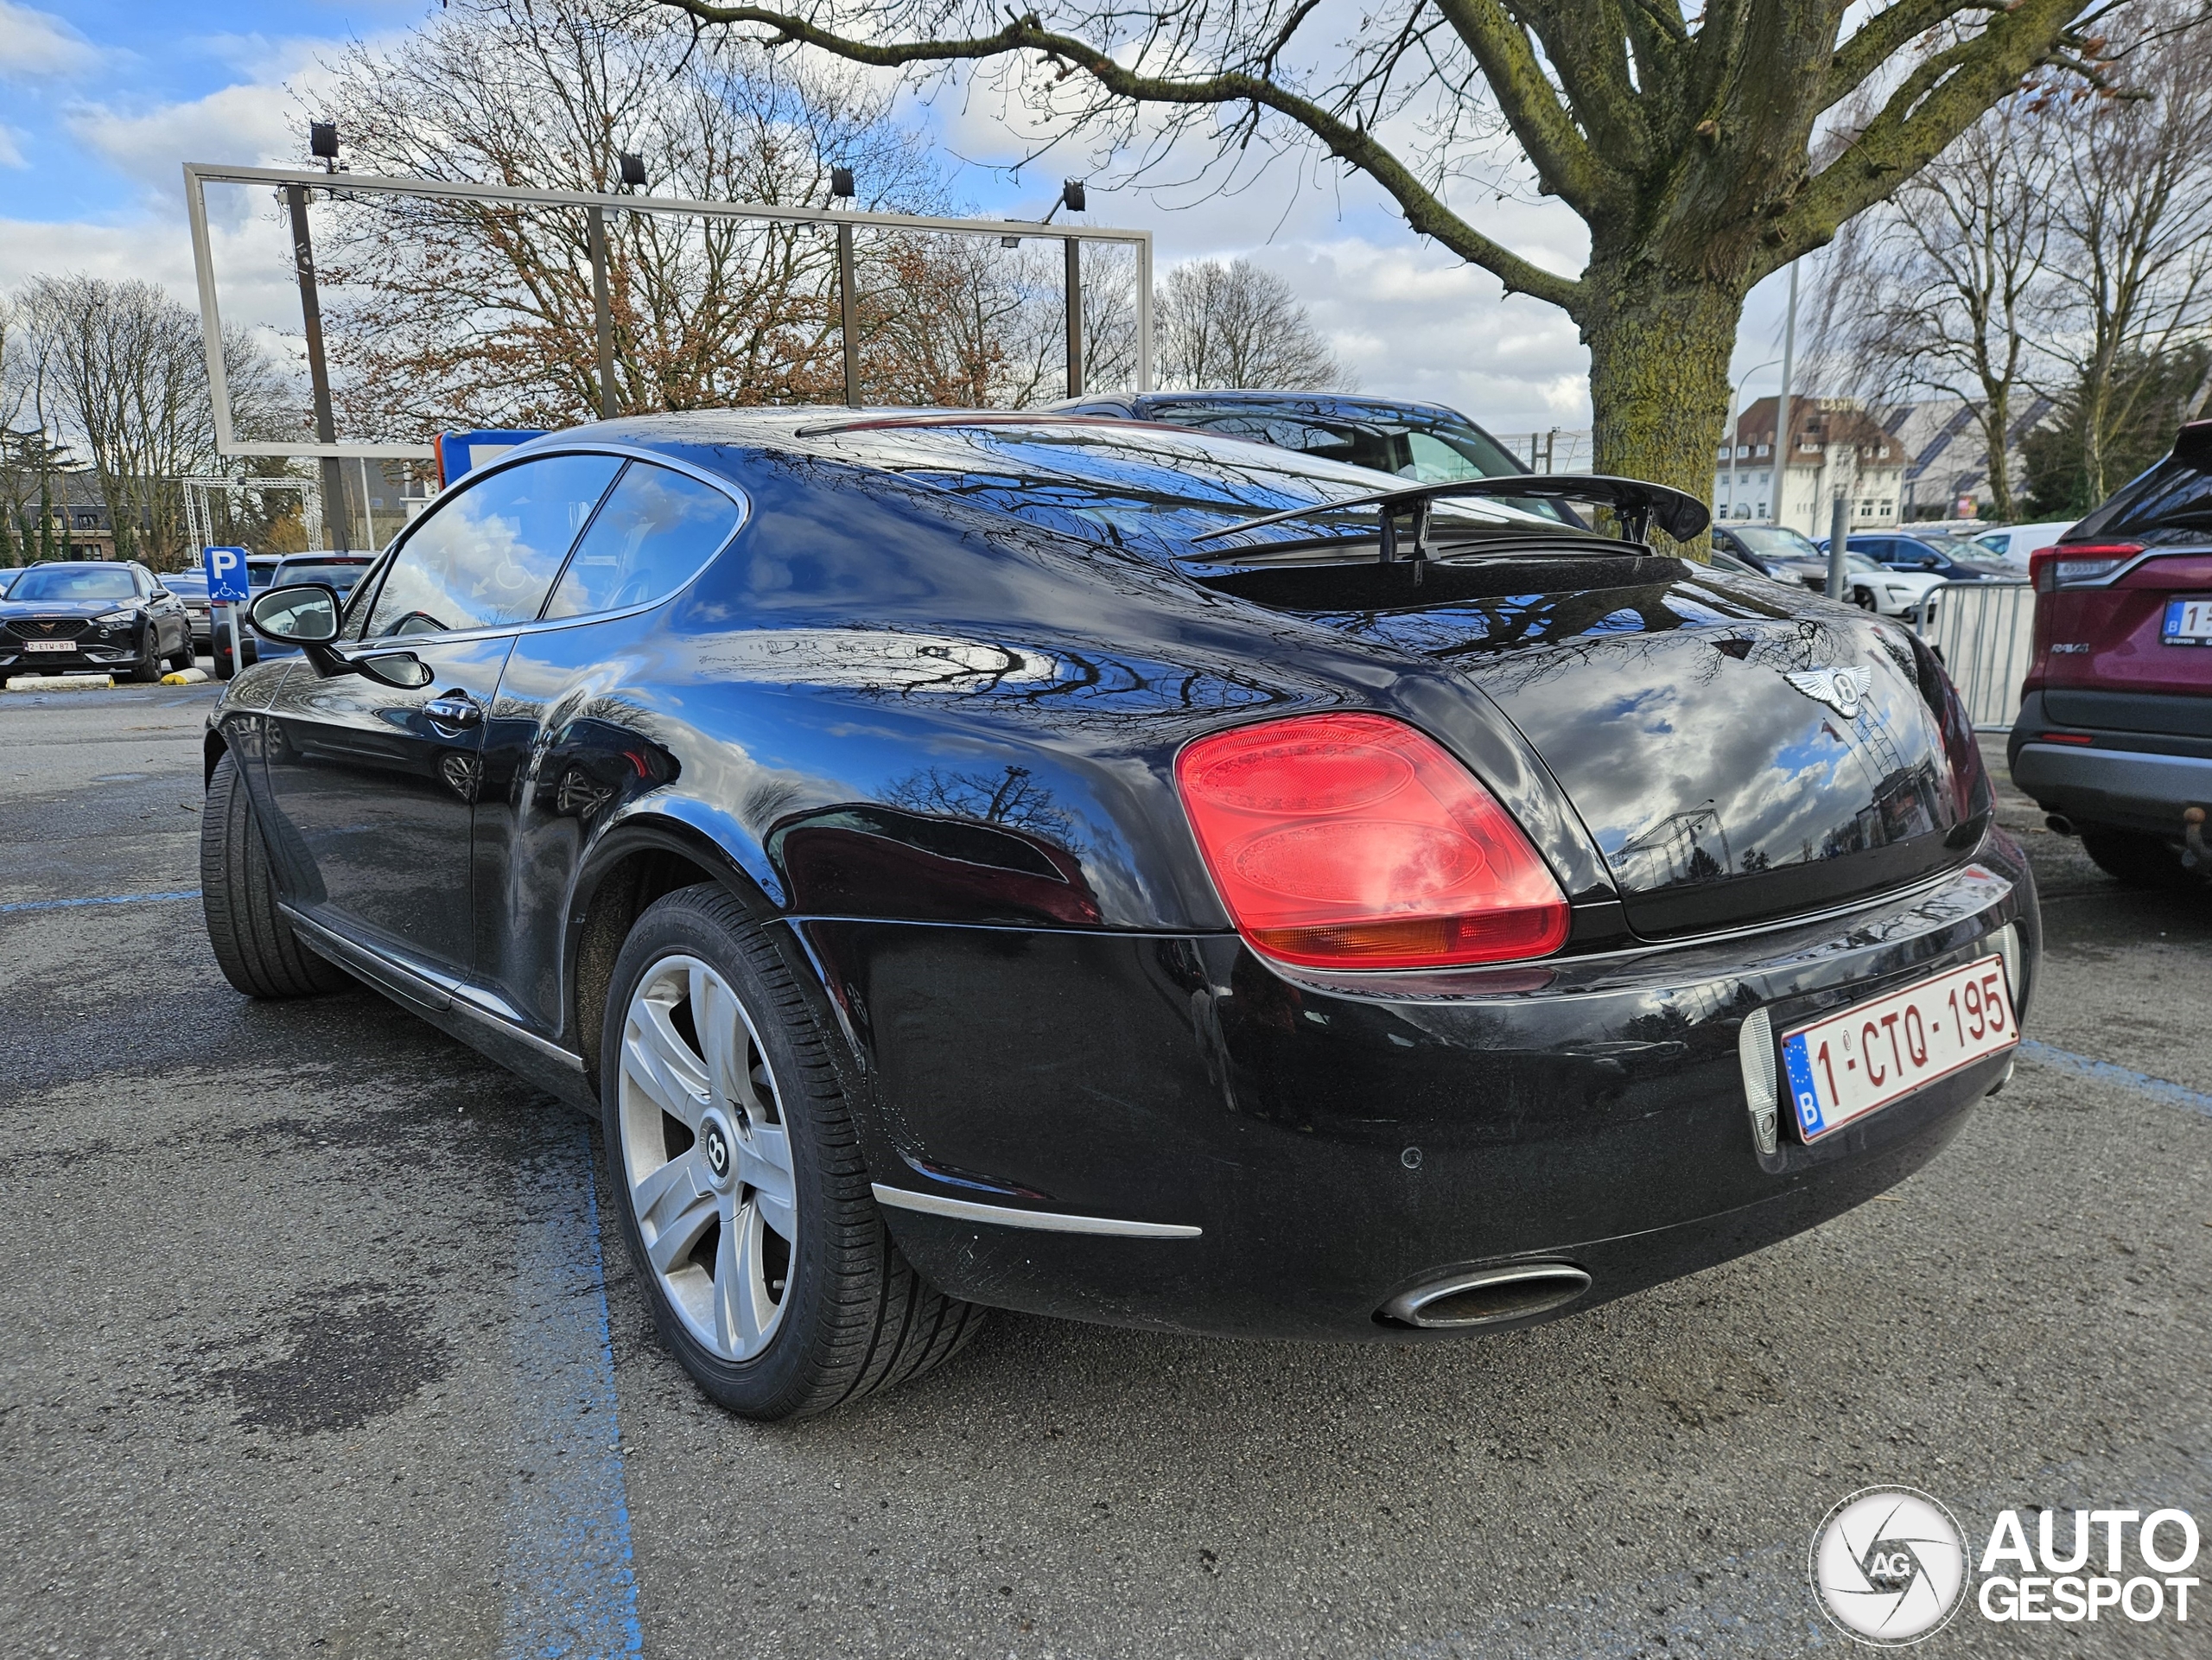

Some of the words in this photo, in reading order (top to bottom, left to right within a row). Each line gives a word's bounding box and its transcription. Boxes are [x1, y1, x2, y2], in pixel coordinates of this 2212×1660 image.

[212, 550, 238, 579] P
[2168, 620, 2178, 633] B
[1798, 1091, 1818, 1126] B
[1818, 972, 2005, 1107] 1-CTQ-195
[709, 1133, 726, 1171] B
